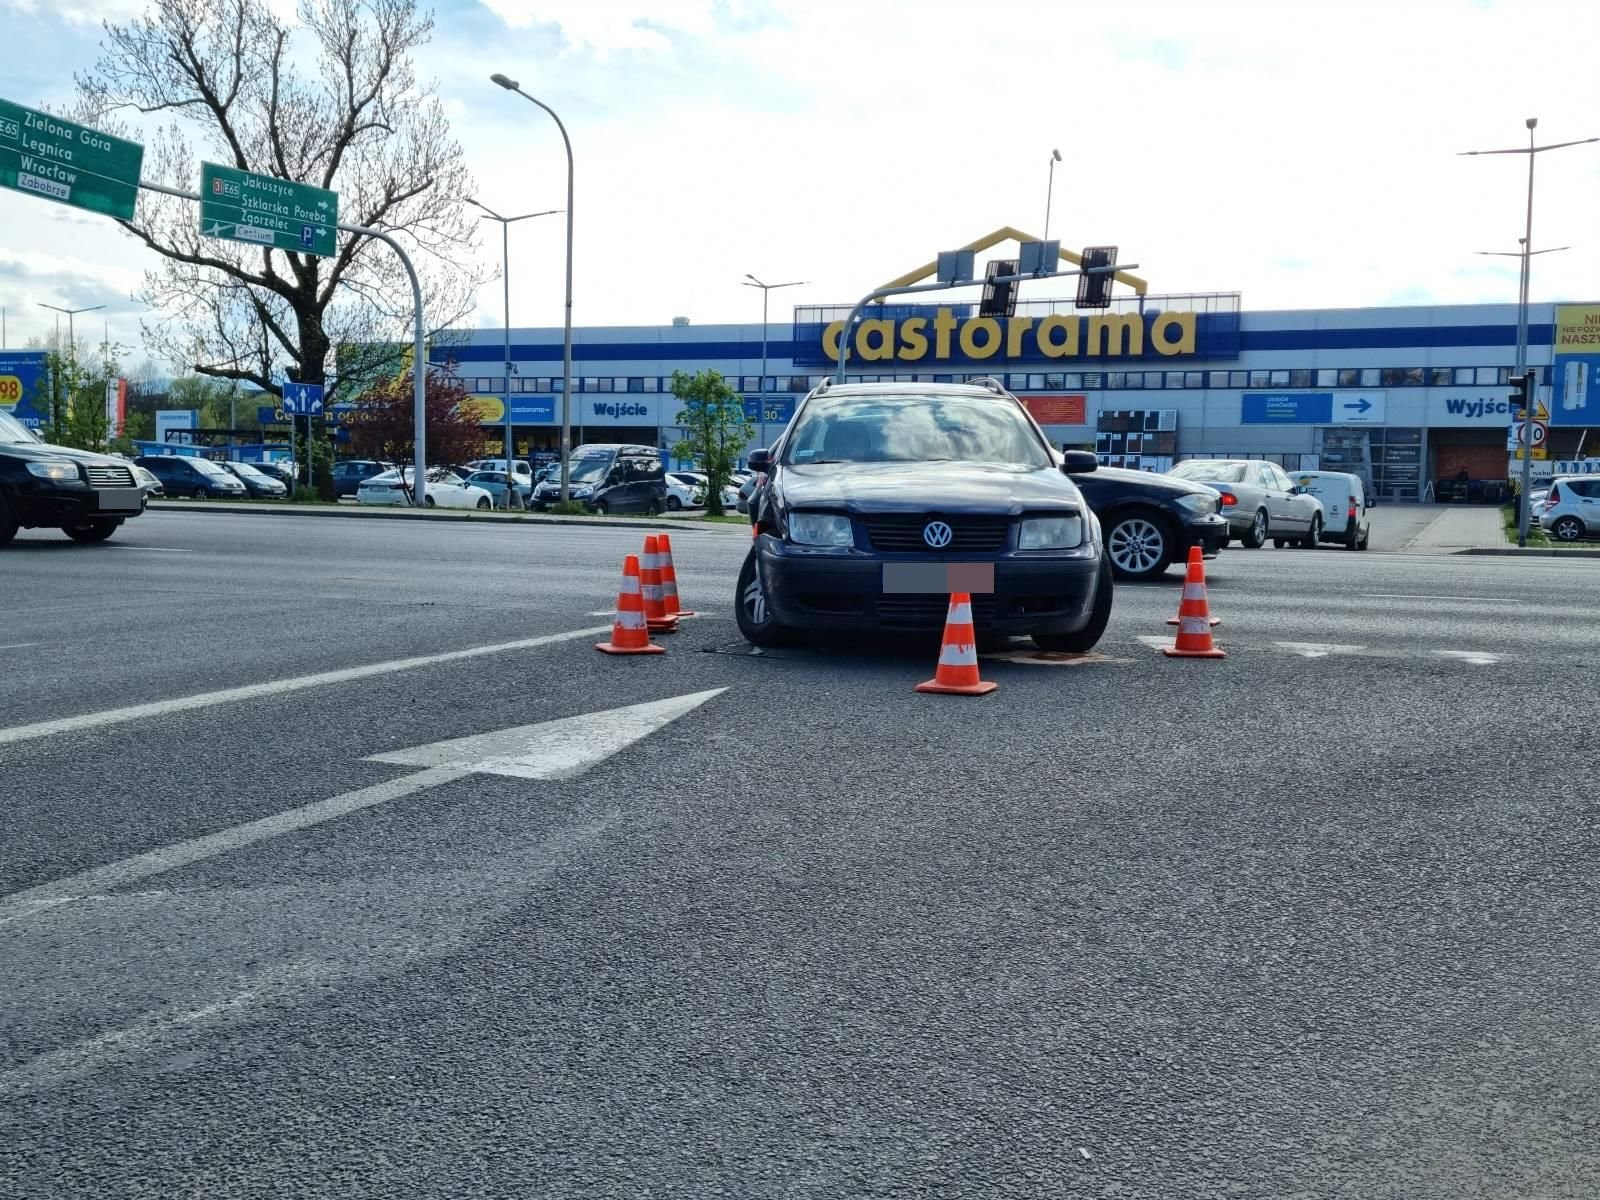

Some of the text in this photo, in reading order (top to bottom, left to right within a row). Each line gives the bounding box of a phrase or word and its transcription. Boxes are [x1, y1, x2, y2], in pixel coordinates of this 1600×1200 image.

[24, 111, 111, 152] Zielona Góra
[22, 133, 73, 160] Legnica
[20, 154, 77, 184] Wrocław
[21, 174, 67, 197] Zabobrze
[214, 181, 239, 196] 3 E65
[242, 175, 294, 197] Jakuszyce
[241, 209, 289, 230] Zgorzelec
[242, 194, 326, 223] Szklarska Poręba
[822, 308, 1198, 361] castorama
[593, 402, 648, 419] Wejście
[1446, 398, 1510, 418] Wyjśc
[925, 522, 951, 546] VW
